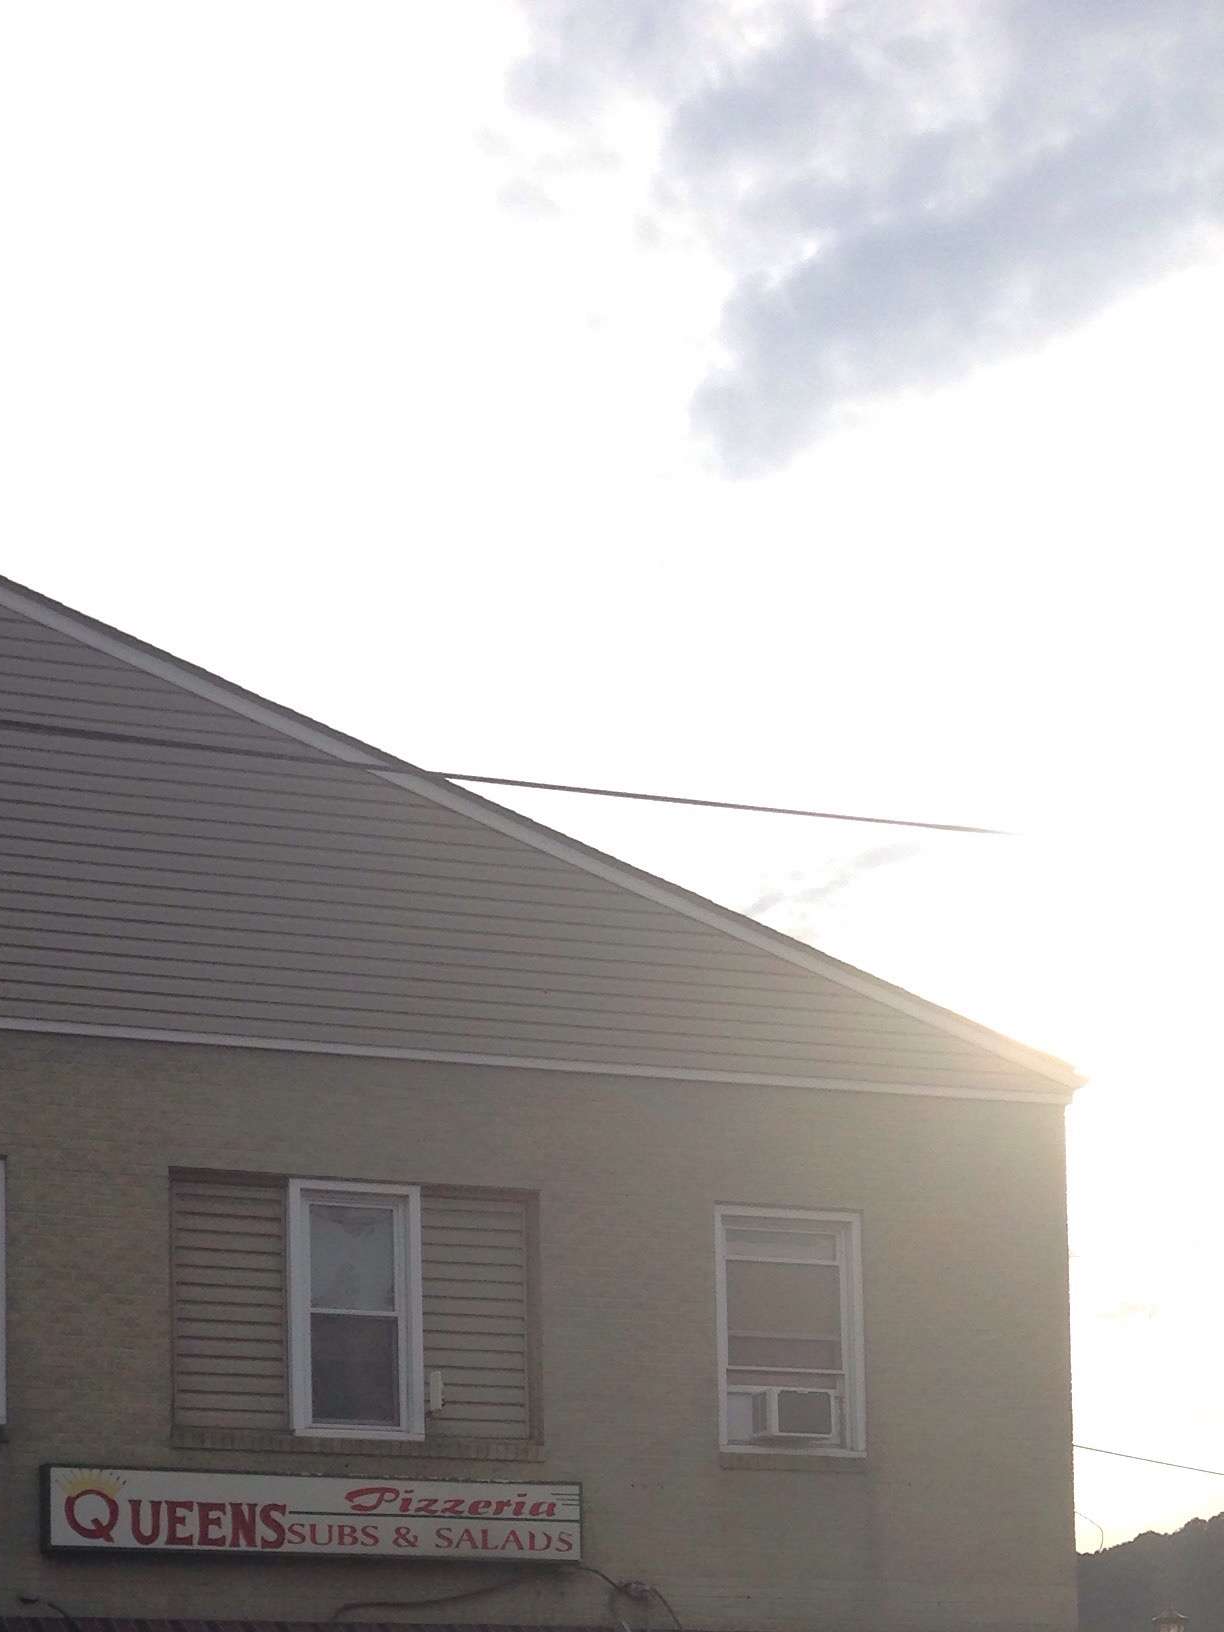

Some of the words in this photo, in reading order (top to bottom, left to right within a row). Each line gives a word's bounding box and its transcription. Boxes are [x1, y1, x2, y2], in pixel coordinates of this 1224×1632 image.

[64, 1487, 287, 1549] QUEENS
[344, 1486, 558, 1518] Pizzeria
[286, 1522, 380, 1547] SUBS
[391, 1528, 419, 1548] &
[434, 1528, 574, 1553] SALADS
